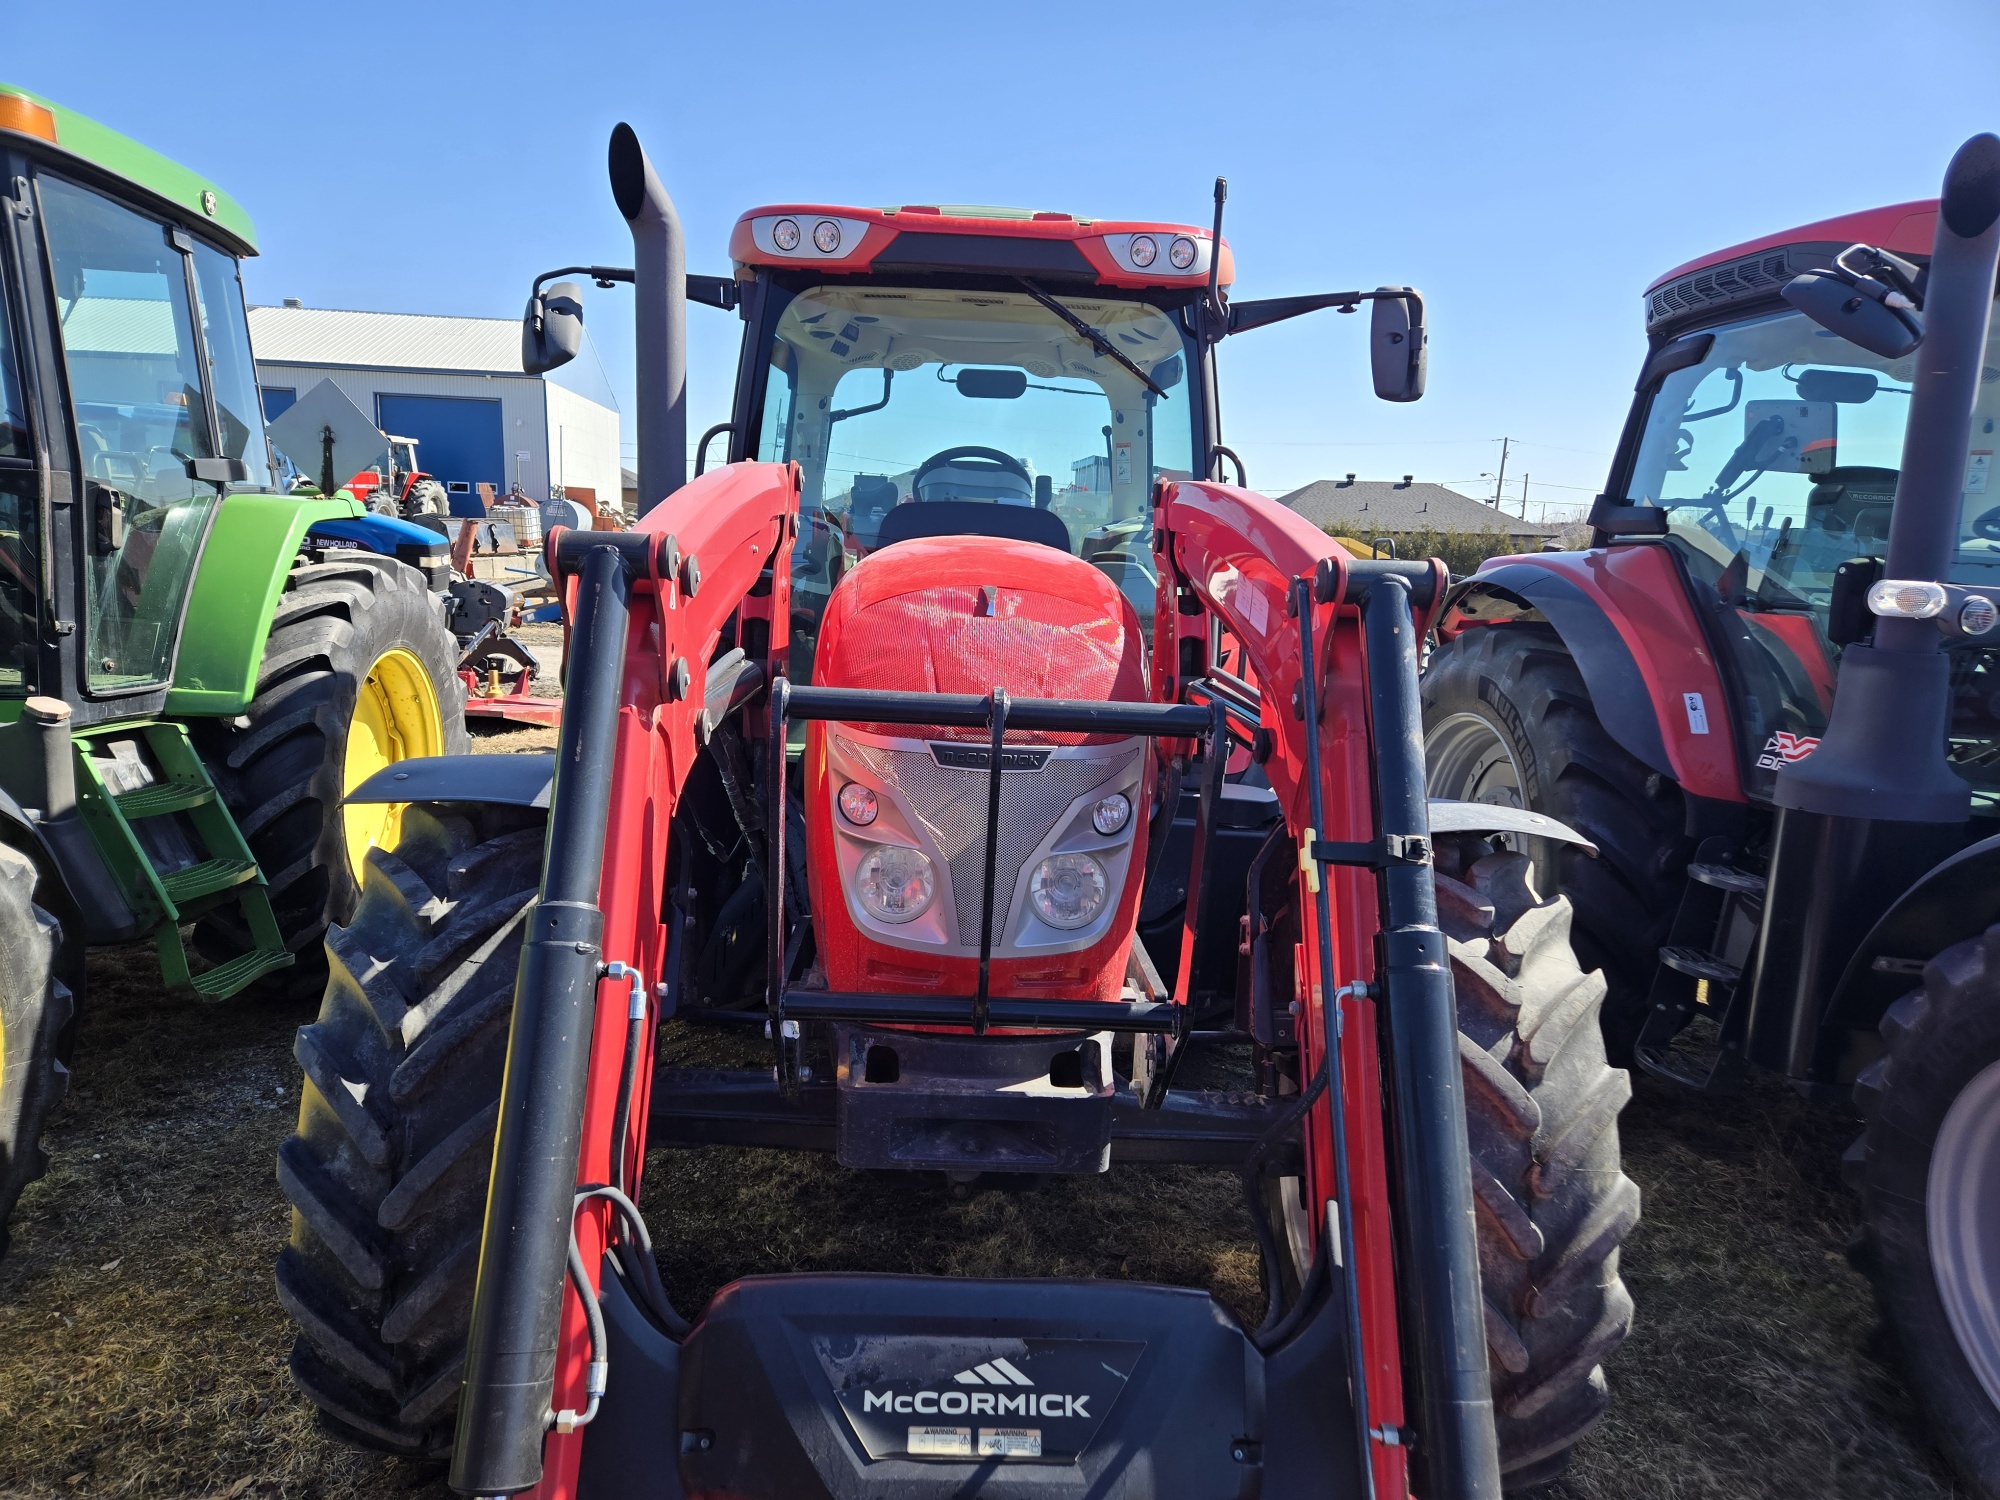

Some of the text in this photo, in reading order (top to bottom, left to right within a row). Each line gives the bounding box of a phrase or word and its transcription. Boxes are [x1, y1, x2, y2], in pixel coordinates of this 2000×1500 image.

[316, 538, 330, 547] NEW
[329, 540, 358, 549] HOLLAND
[1486, 683, 1539, 801] MULTIBIB
[941, 750, 1040, 766] McCOMICK
[863, 1389, 1092, 1419] McCORMICK
